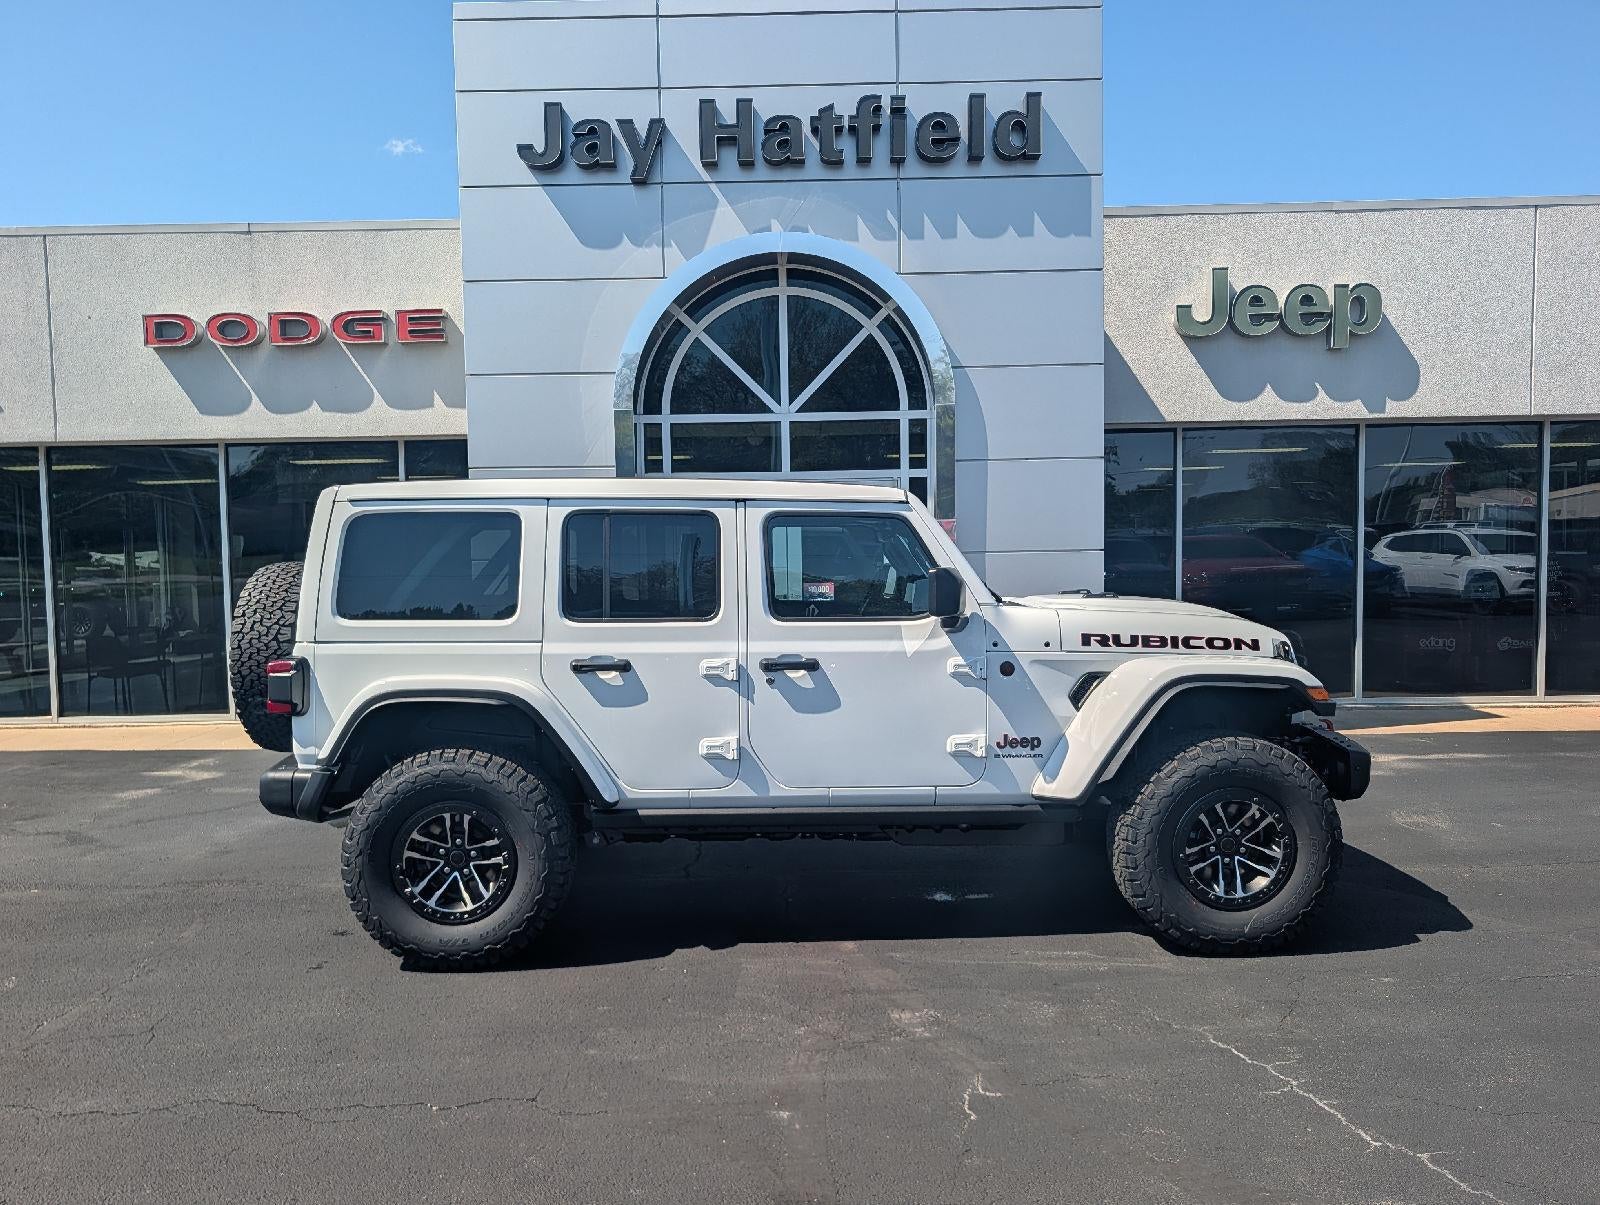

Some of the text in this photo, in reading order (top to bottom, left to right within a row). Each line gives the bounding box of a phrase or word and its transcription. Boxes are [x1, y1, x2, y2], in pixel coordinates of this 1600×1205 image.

[516, 91, 1042, 183] Jay Hatfield
[142, 308, 448, 347] DODGE
[1176, 267, 1383, 350] Jeep
[1081, 633, 1261, 652] RUBICON
[995, 733, 1042, 751] Jeep
